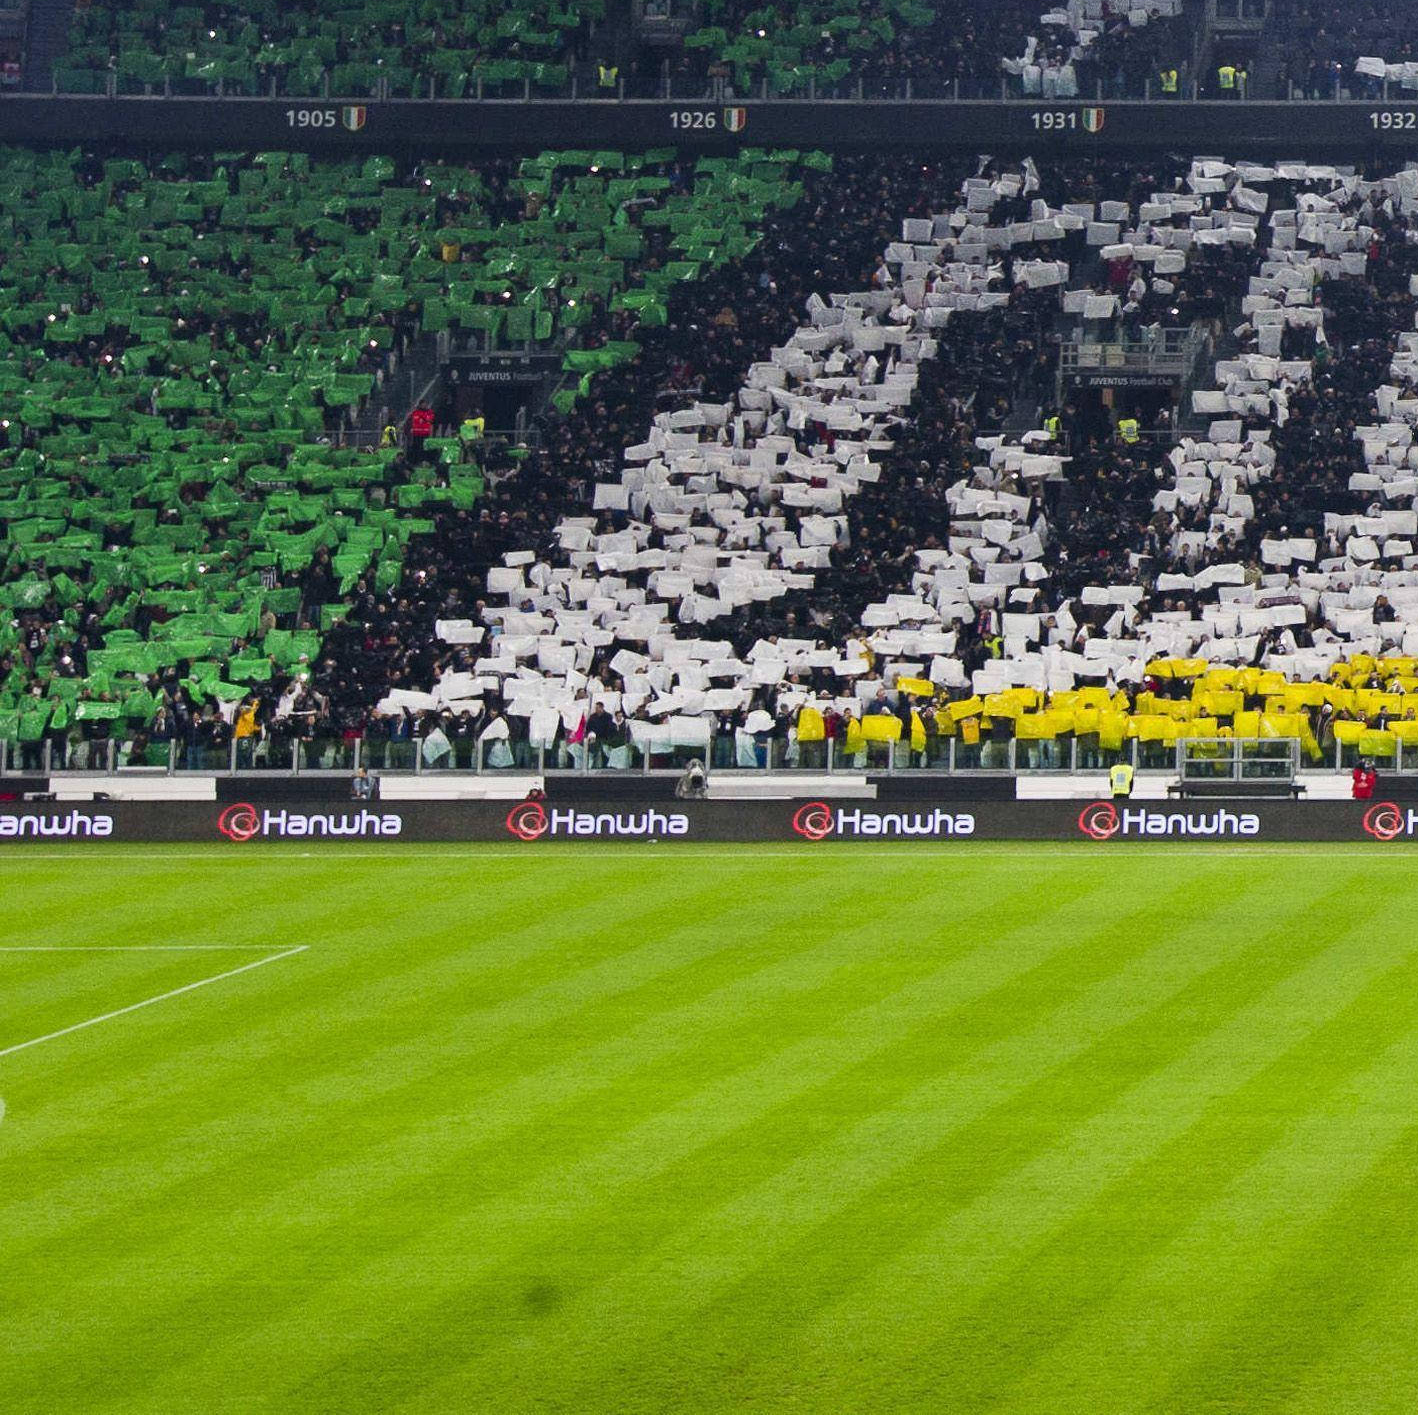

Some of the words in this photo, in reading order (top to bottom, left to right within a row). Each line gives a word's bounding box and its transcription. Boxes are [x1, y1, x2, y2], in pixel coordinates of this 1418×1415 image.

[286, 110, 336, 128] 1905
[670, 111, 716, 129] 1926
[1032, 112, 1076, 129] 1931
[1370, 112, 1416, 129] 1932
[469, 372, 511, 381] JUVENTUS
[1089, 377, 1128, 386] JUVENTUS
[0, 810, 112, 835] anwha
[262, 810, 401, 835] Hanwha
[550, 809, 688, 835] Hanwha
[837, 809, 974, 834] Hanwha
[1121, 809, 1259, 833] Hanwha
